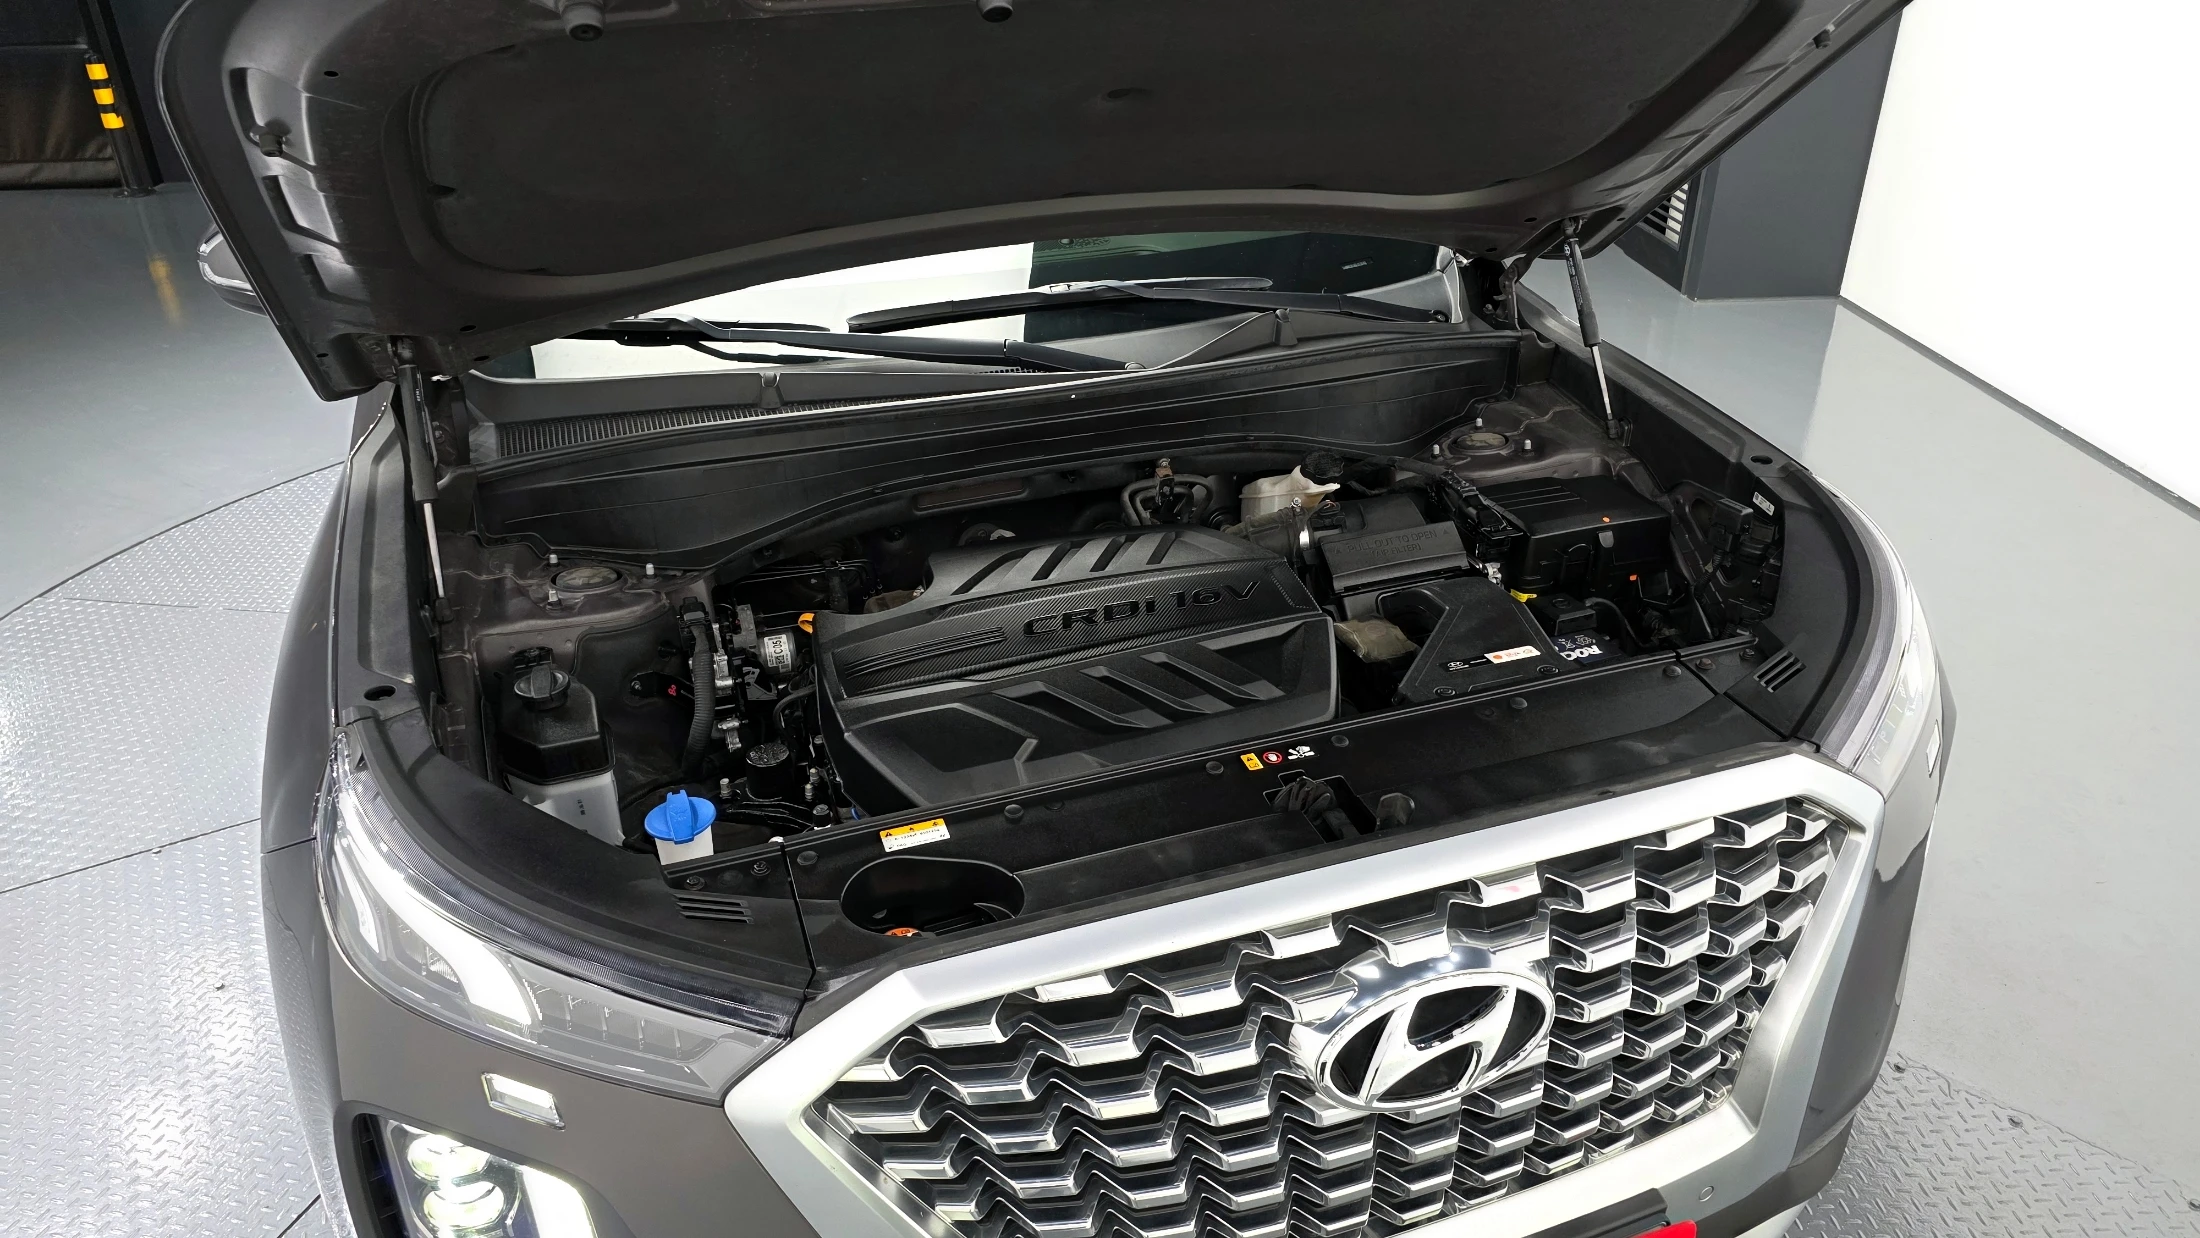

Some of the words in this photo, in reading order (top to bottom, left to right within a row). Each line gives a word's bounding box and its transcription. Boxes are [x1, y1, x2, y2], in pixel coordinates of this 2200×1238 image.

[1346, 541, 1373, 553] PULL
[1374, 537, 1394, 548] OUT
[1395, 534, 1410, 544] TO
[1411, 529, 1438, 541] OPEN
[1168, 580, 1261, 611] 16V
[1555, 644, 1604, 661] ROC
